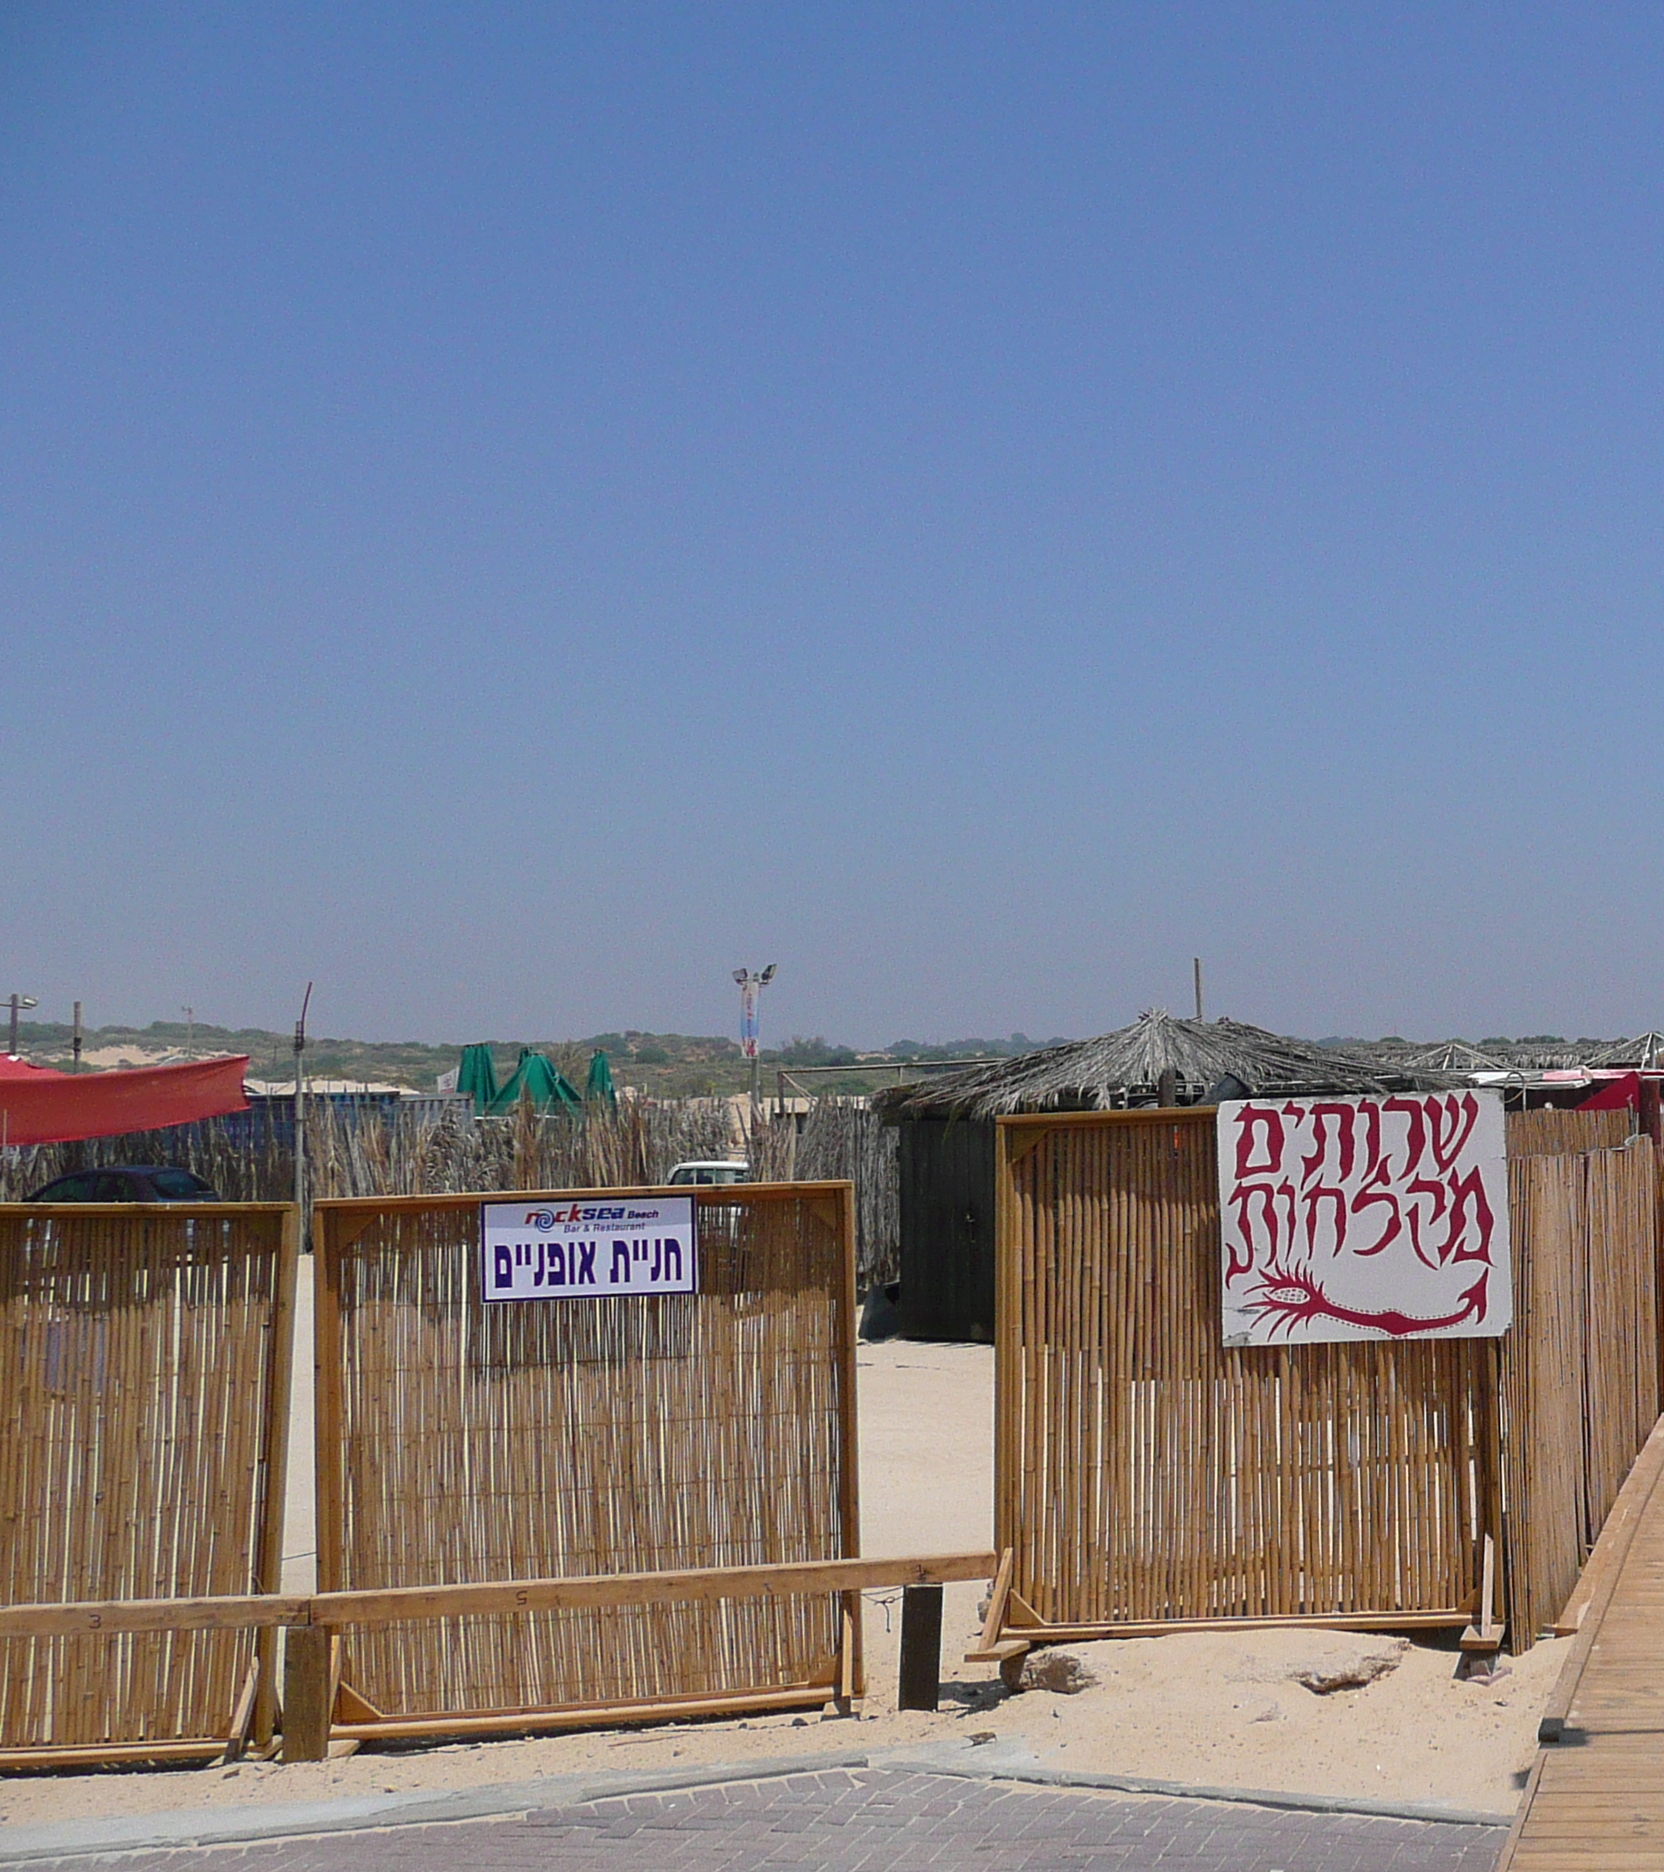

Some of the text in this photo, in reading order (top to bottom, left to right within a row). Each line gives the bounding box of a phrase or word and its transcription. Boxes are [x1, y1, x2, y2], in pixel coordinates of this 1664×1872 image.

[1233, 1091, 1479, 1191] שרותים
[564, 1222, 646, 1233] Bar & Restaurant
[627, 1210, 660, 1219] Beach
[1225, 1153, 1498, 1290] מקלחות
[493, 1238, 682, 1289] חניית אופניים
